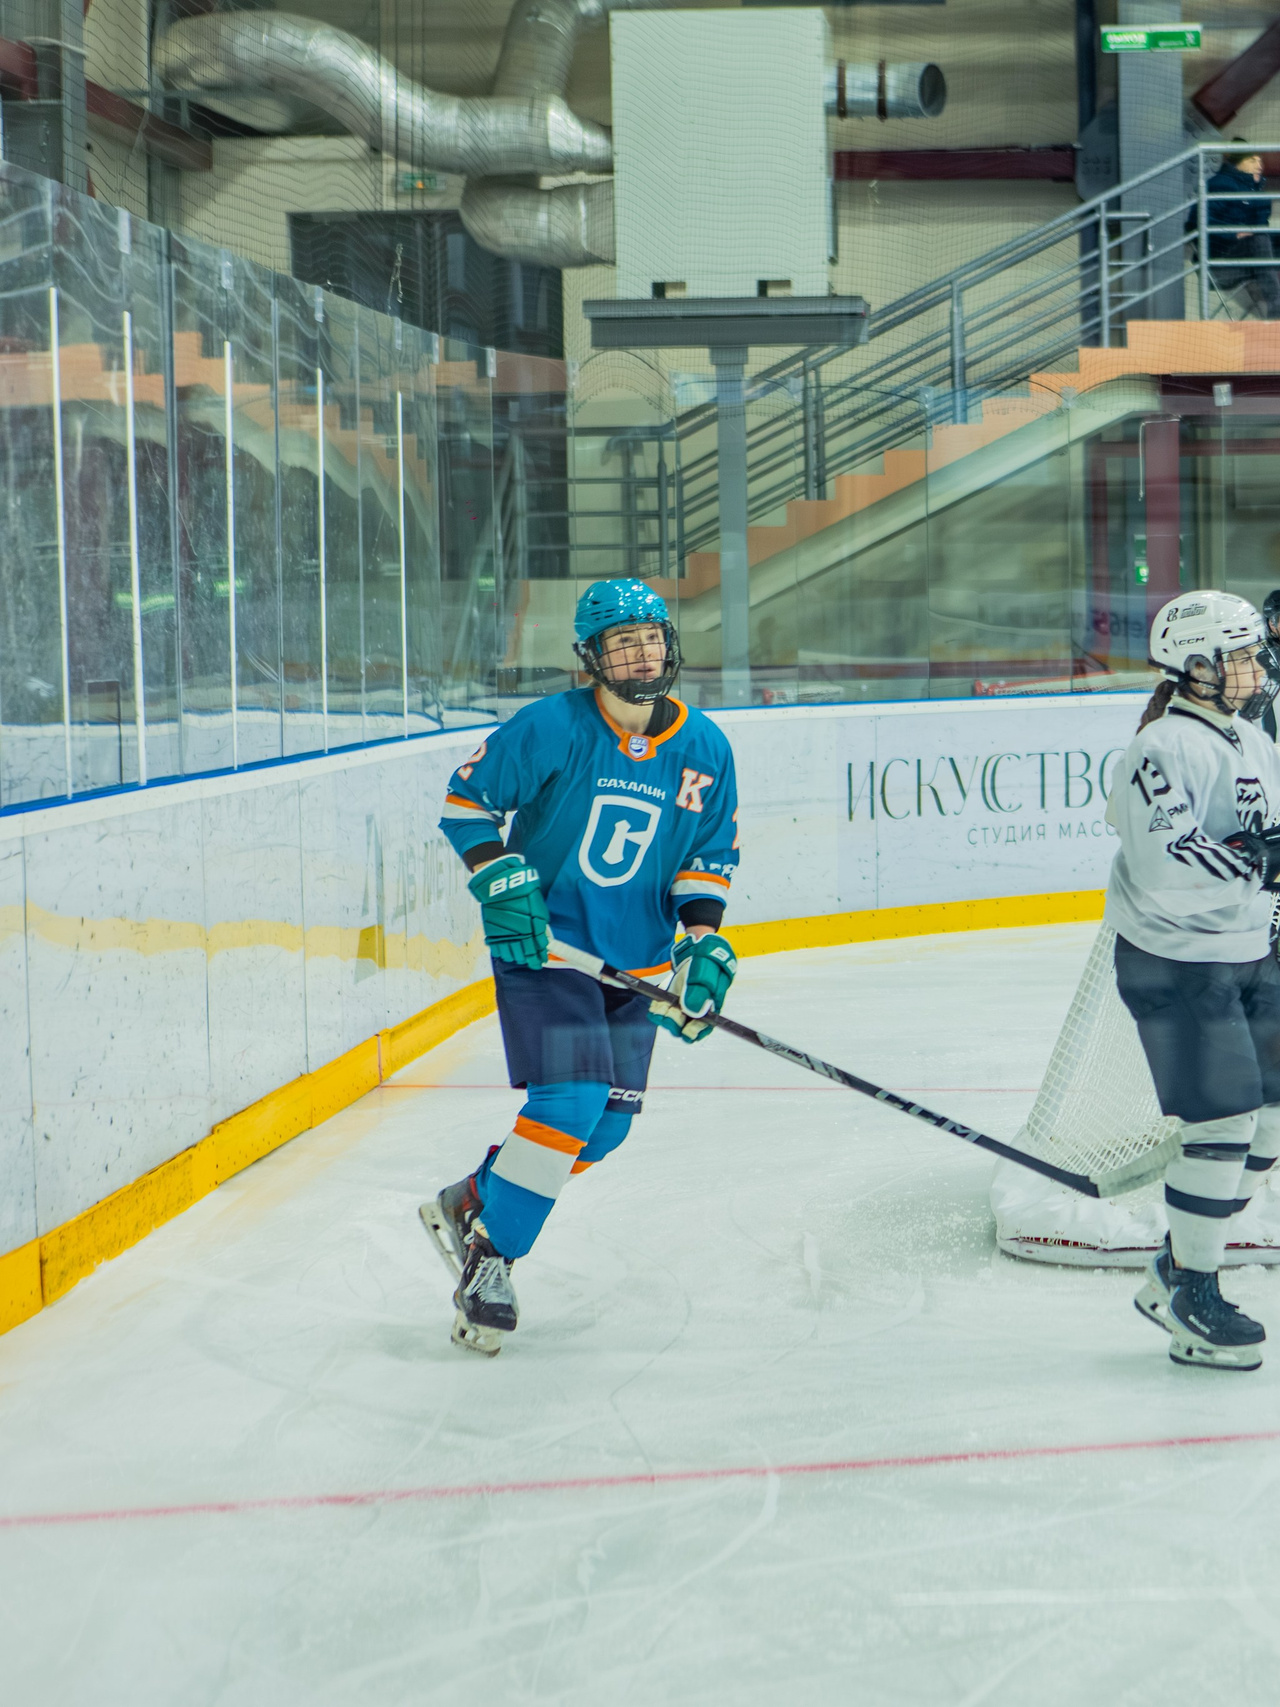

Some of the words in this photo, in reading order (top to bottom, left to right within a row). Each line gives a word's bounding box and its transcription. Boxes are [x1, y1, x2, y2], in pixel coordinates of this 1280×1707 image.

[1178, 636, 1205, 646] CCM
[597, 777, 666, 800] САХАЛИН
[1131, 756, 1172, 807] 13
[967, 823, 1046, 845] СТУДИЯ
[875, 1089, 981, 1143] CCM
